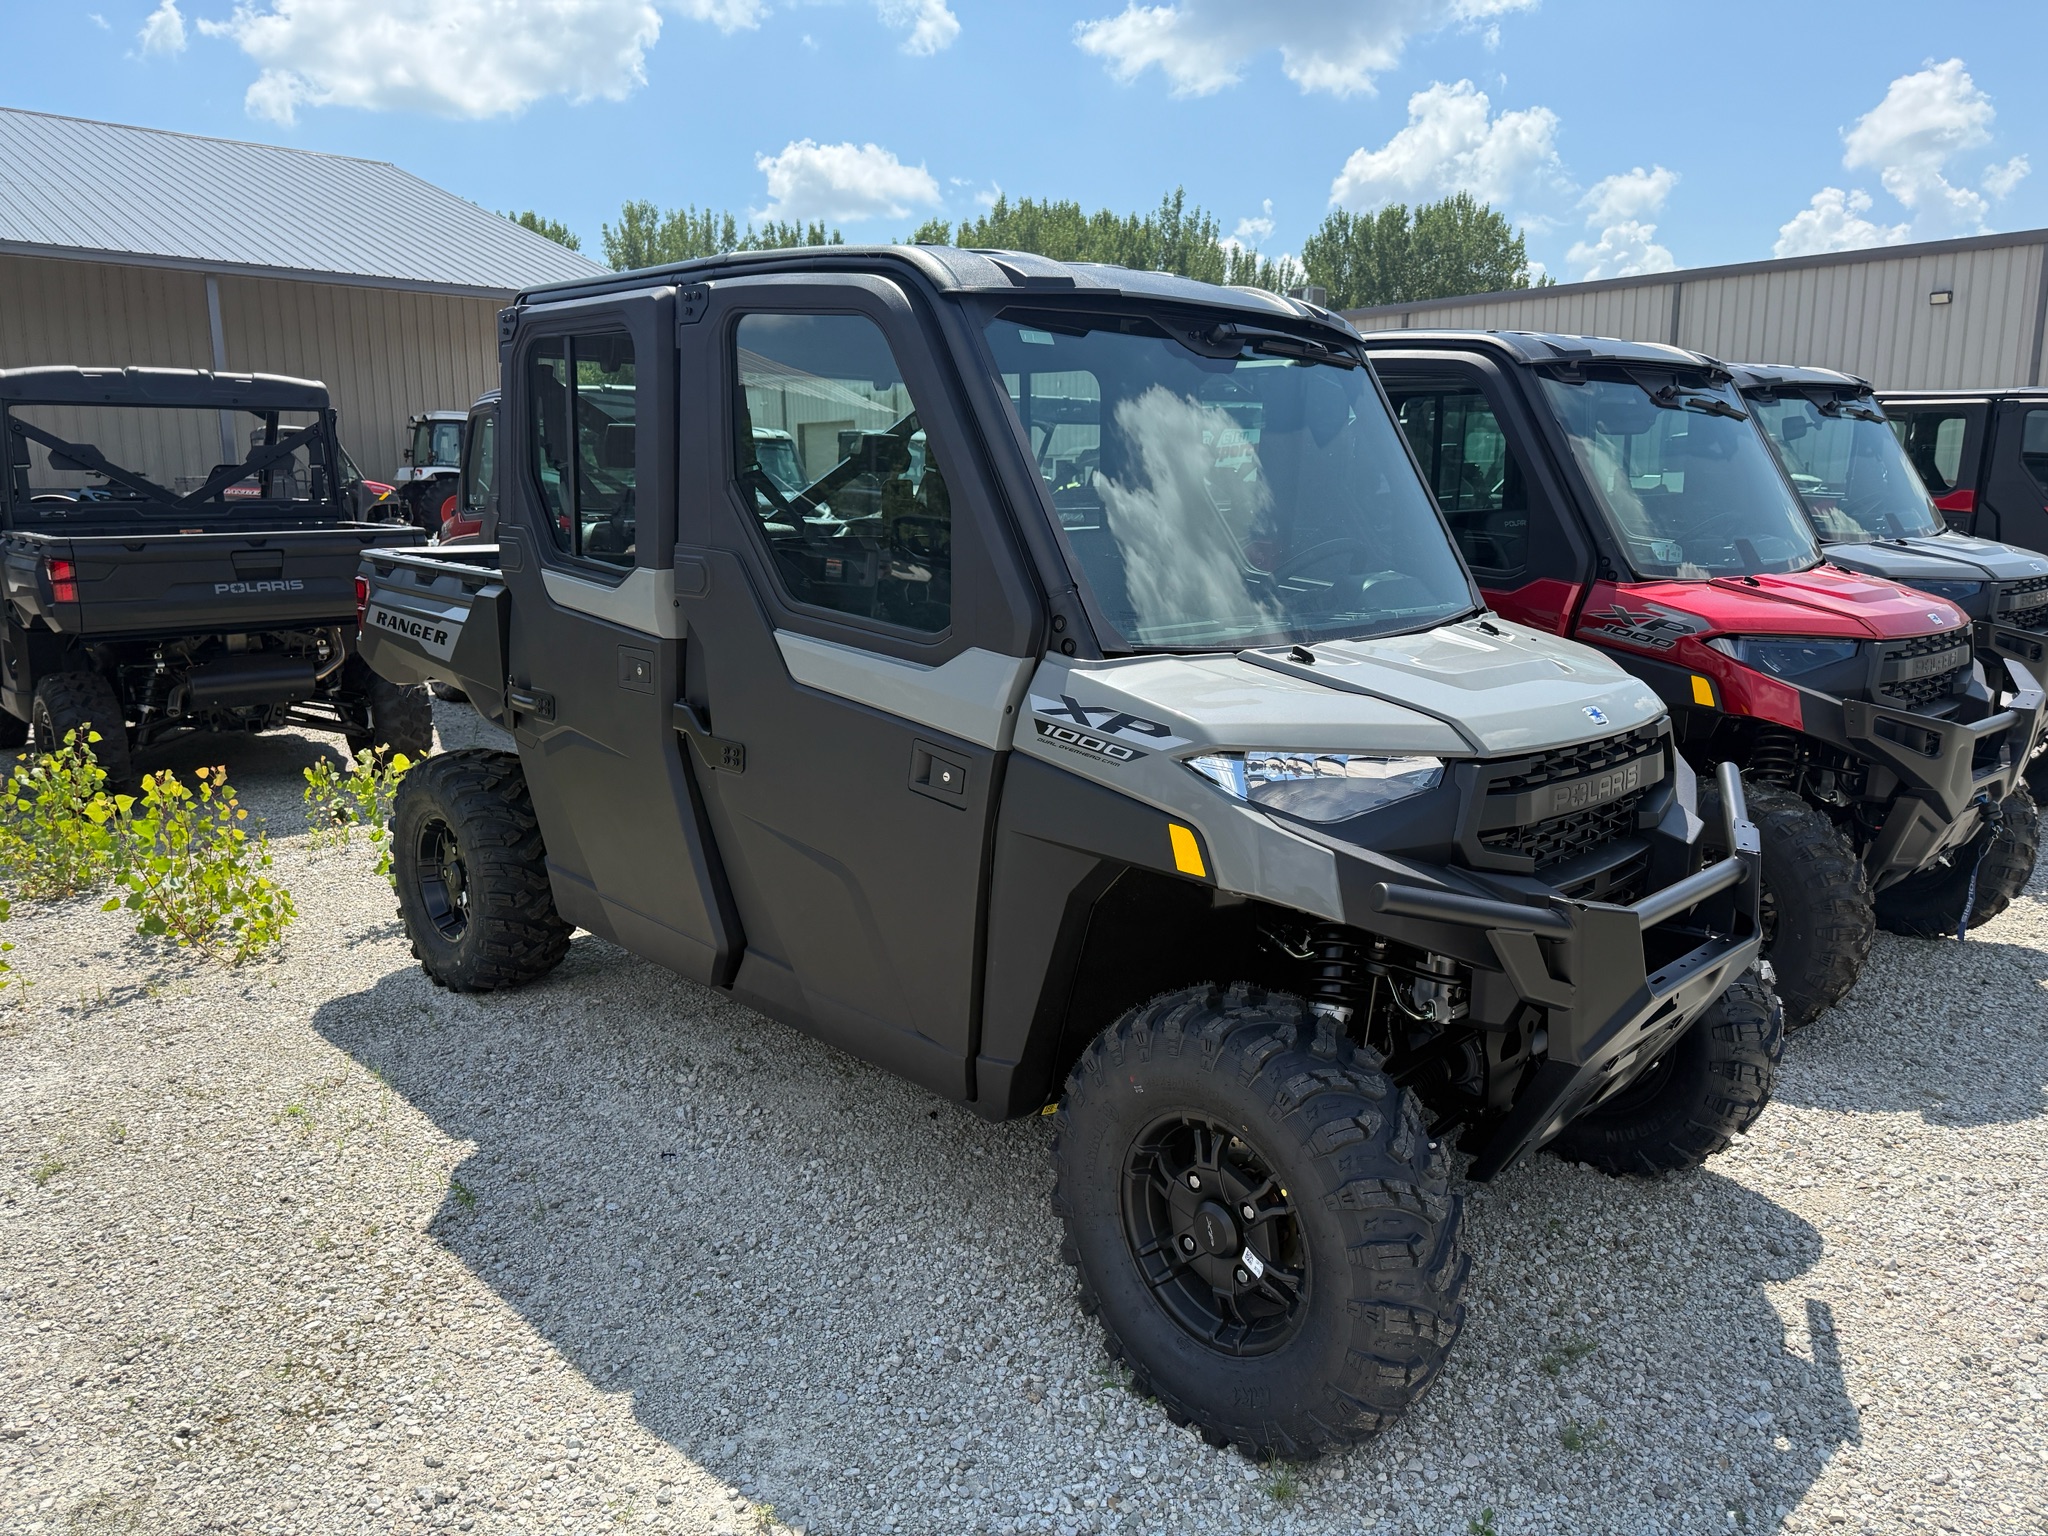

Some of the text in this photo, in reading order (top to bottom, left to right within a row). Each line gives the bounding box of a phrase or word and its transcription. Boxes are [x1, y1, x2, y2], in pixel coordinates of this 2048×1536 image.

[215, 579, 304, 595] POLARIS
[376, 610, 449, 647] RANGER
[1587, 603, 1698, 636] XP
[1602, 623, 1678, 650] 1000
[1035, 693, 1173, 739] XP
[1036, 736, 1121, 769] DUAL OVERHEAD CAM
[1042, 723, 1134, 760] 1000
[1553, 764, 1639, 812] POLARIS
[1961, 874, 1976, 923] POLARIS
